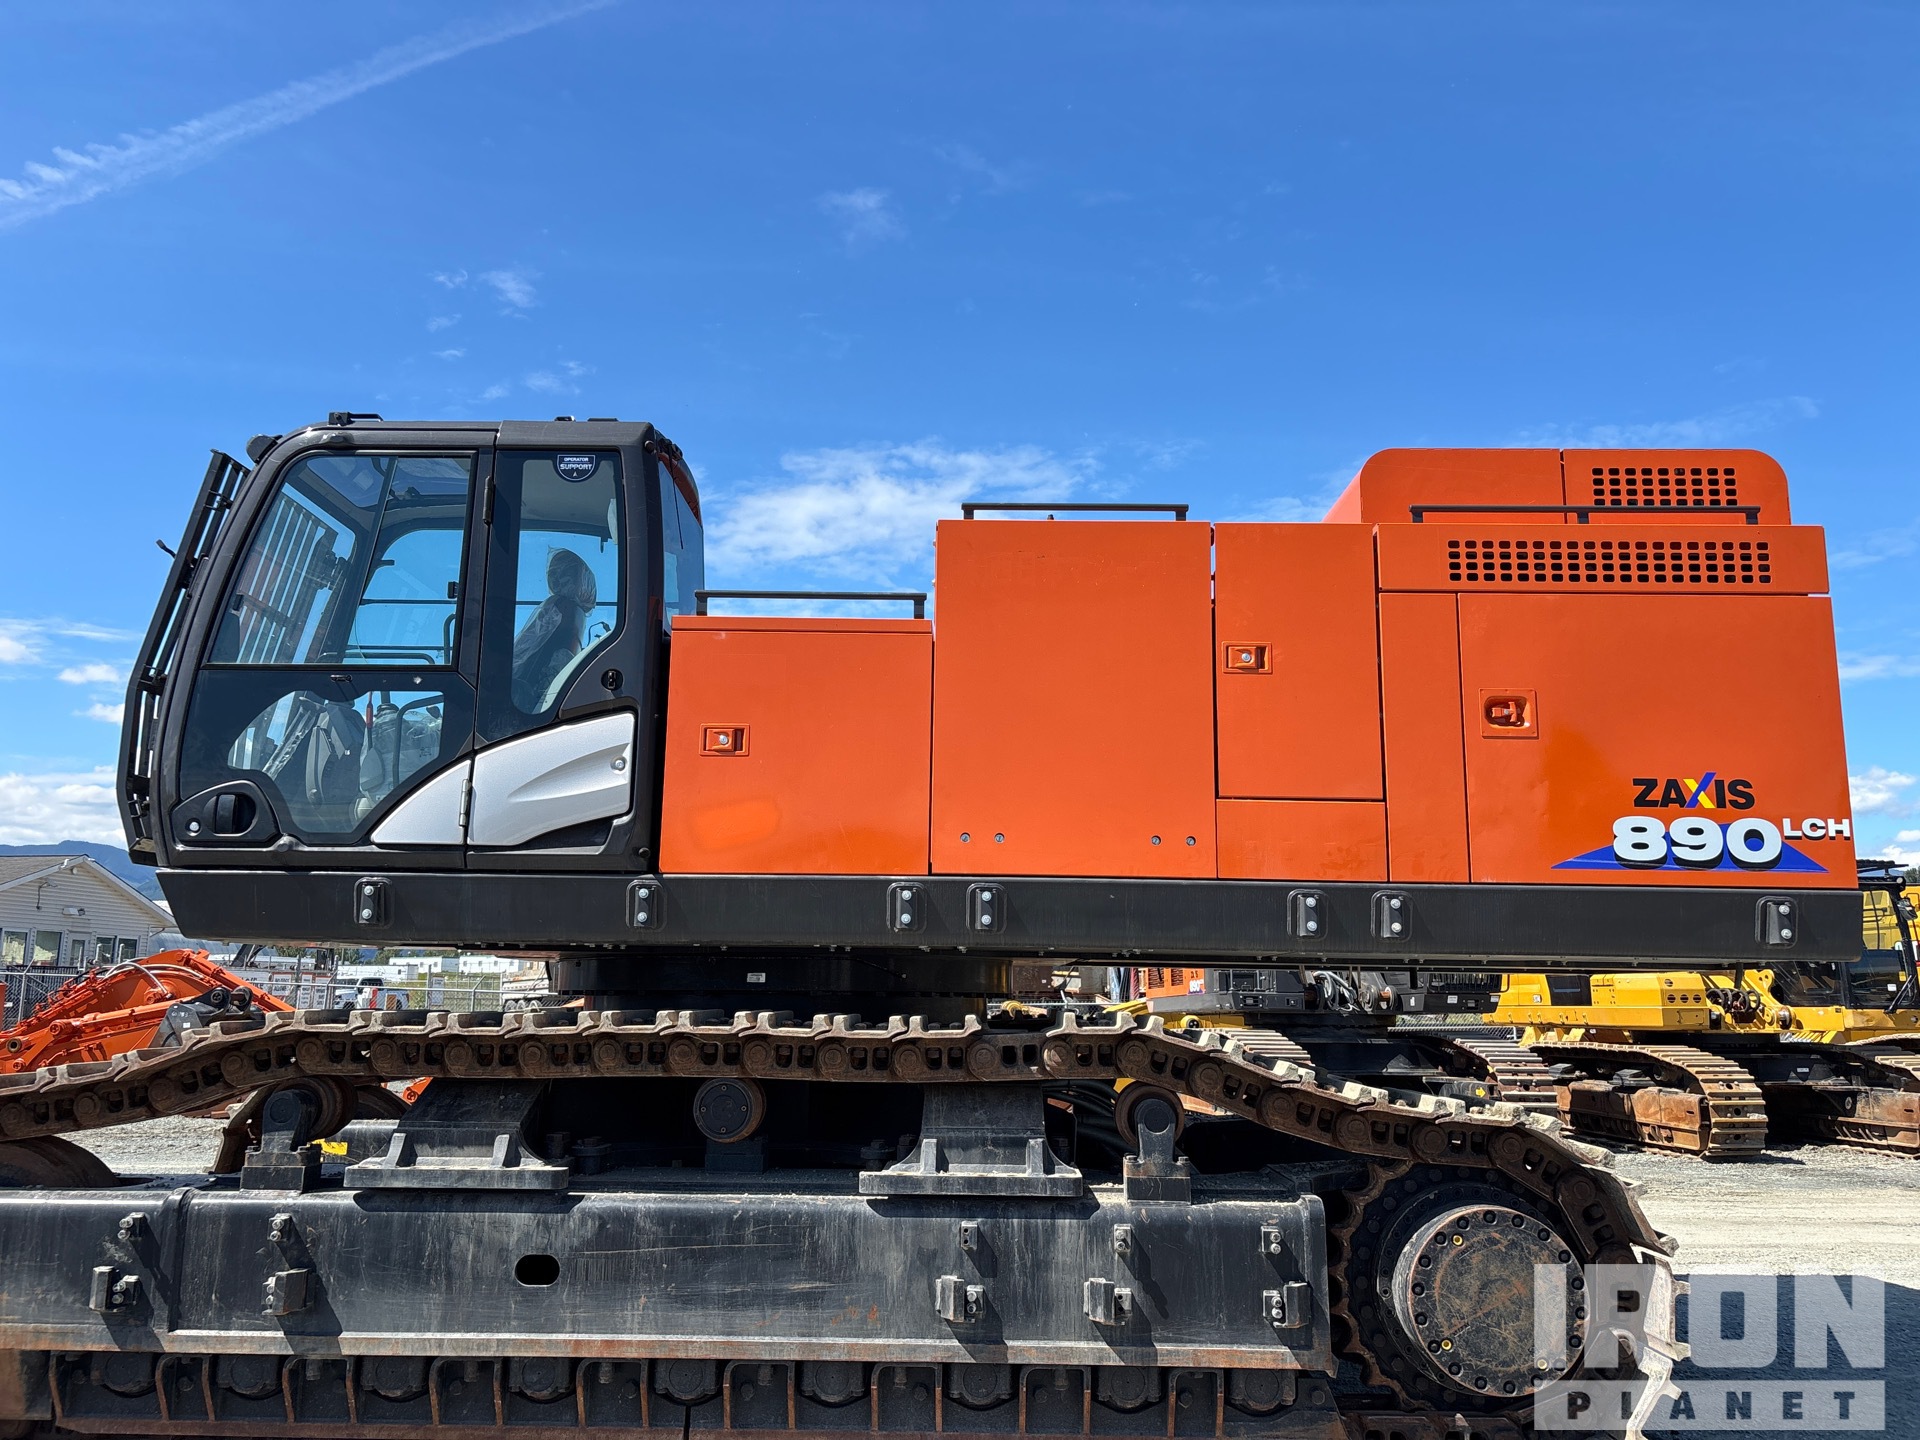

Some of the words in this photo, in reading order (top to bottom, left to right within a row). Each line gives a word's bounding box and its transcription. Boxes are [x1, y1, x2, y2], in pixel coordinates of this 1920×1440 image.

[1632, 771, 1755, 809] ZAXIS
[1612, 816, 1783, 870] 890
[1783, 818, 1851, 840] LCH
